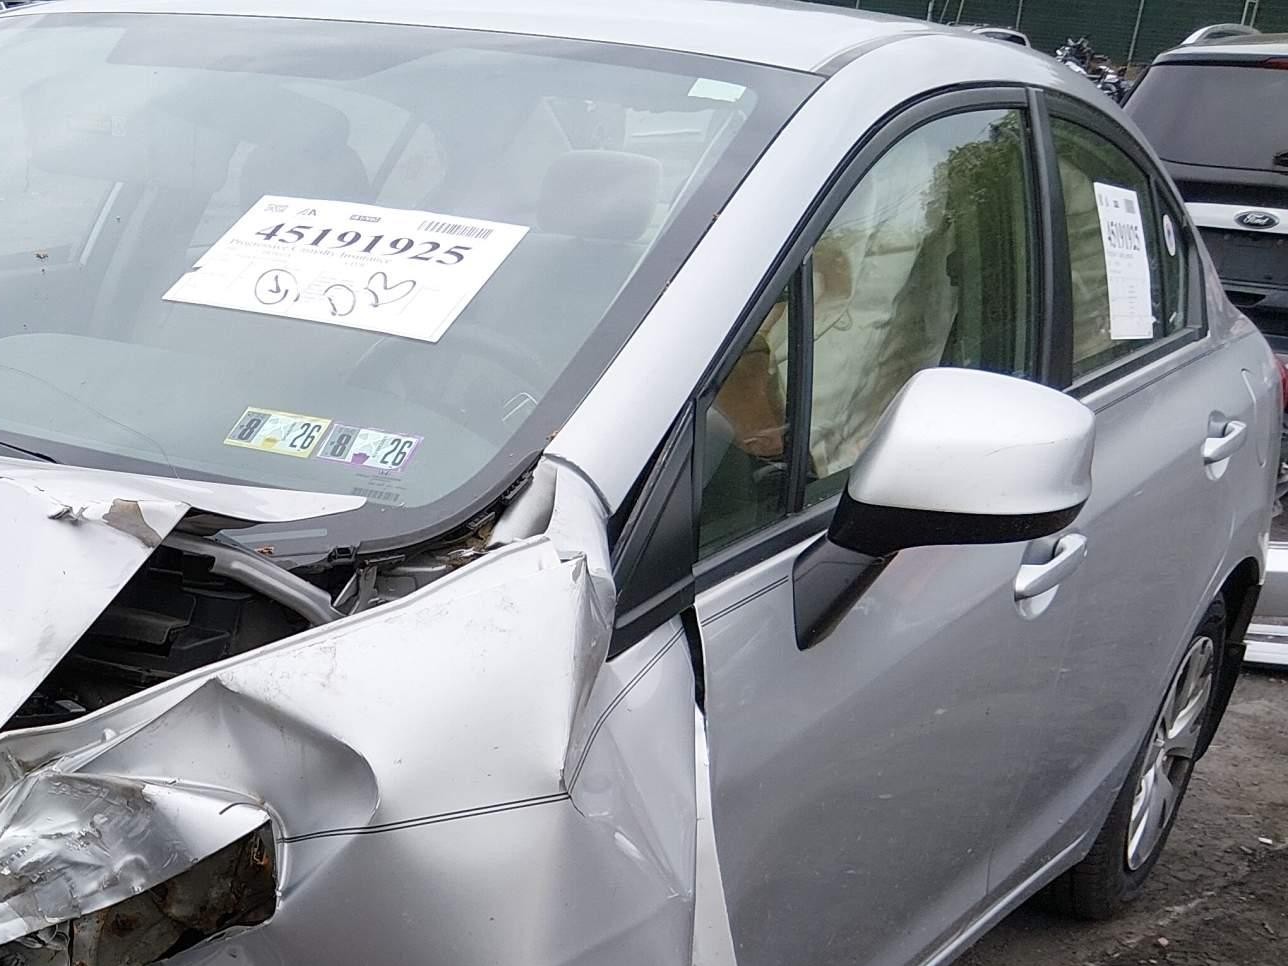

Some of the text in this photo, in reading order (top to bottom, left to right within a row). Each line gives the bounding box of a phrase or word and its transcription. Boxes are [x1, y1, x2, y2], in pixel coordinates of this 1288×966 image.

[1243, 213, 1270, 225] Ford
[255, 222, 472, 265] 45191925
[288, 422, 322, 450] 26
[379, 438, 414, 467] 26
